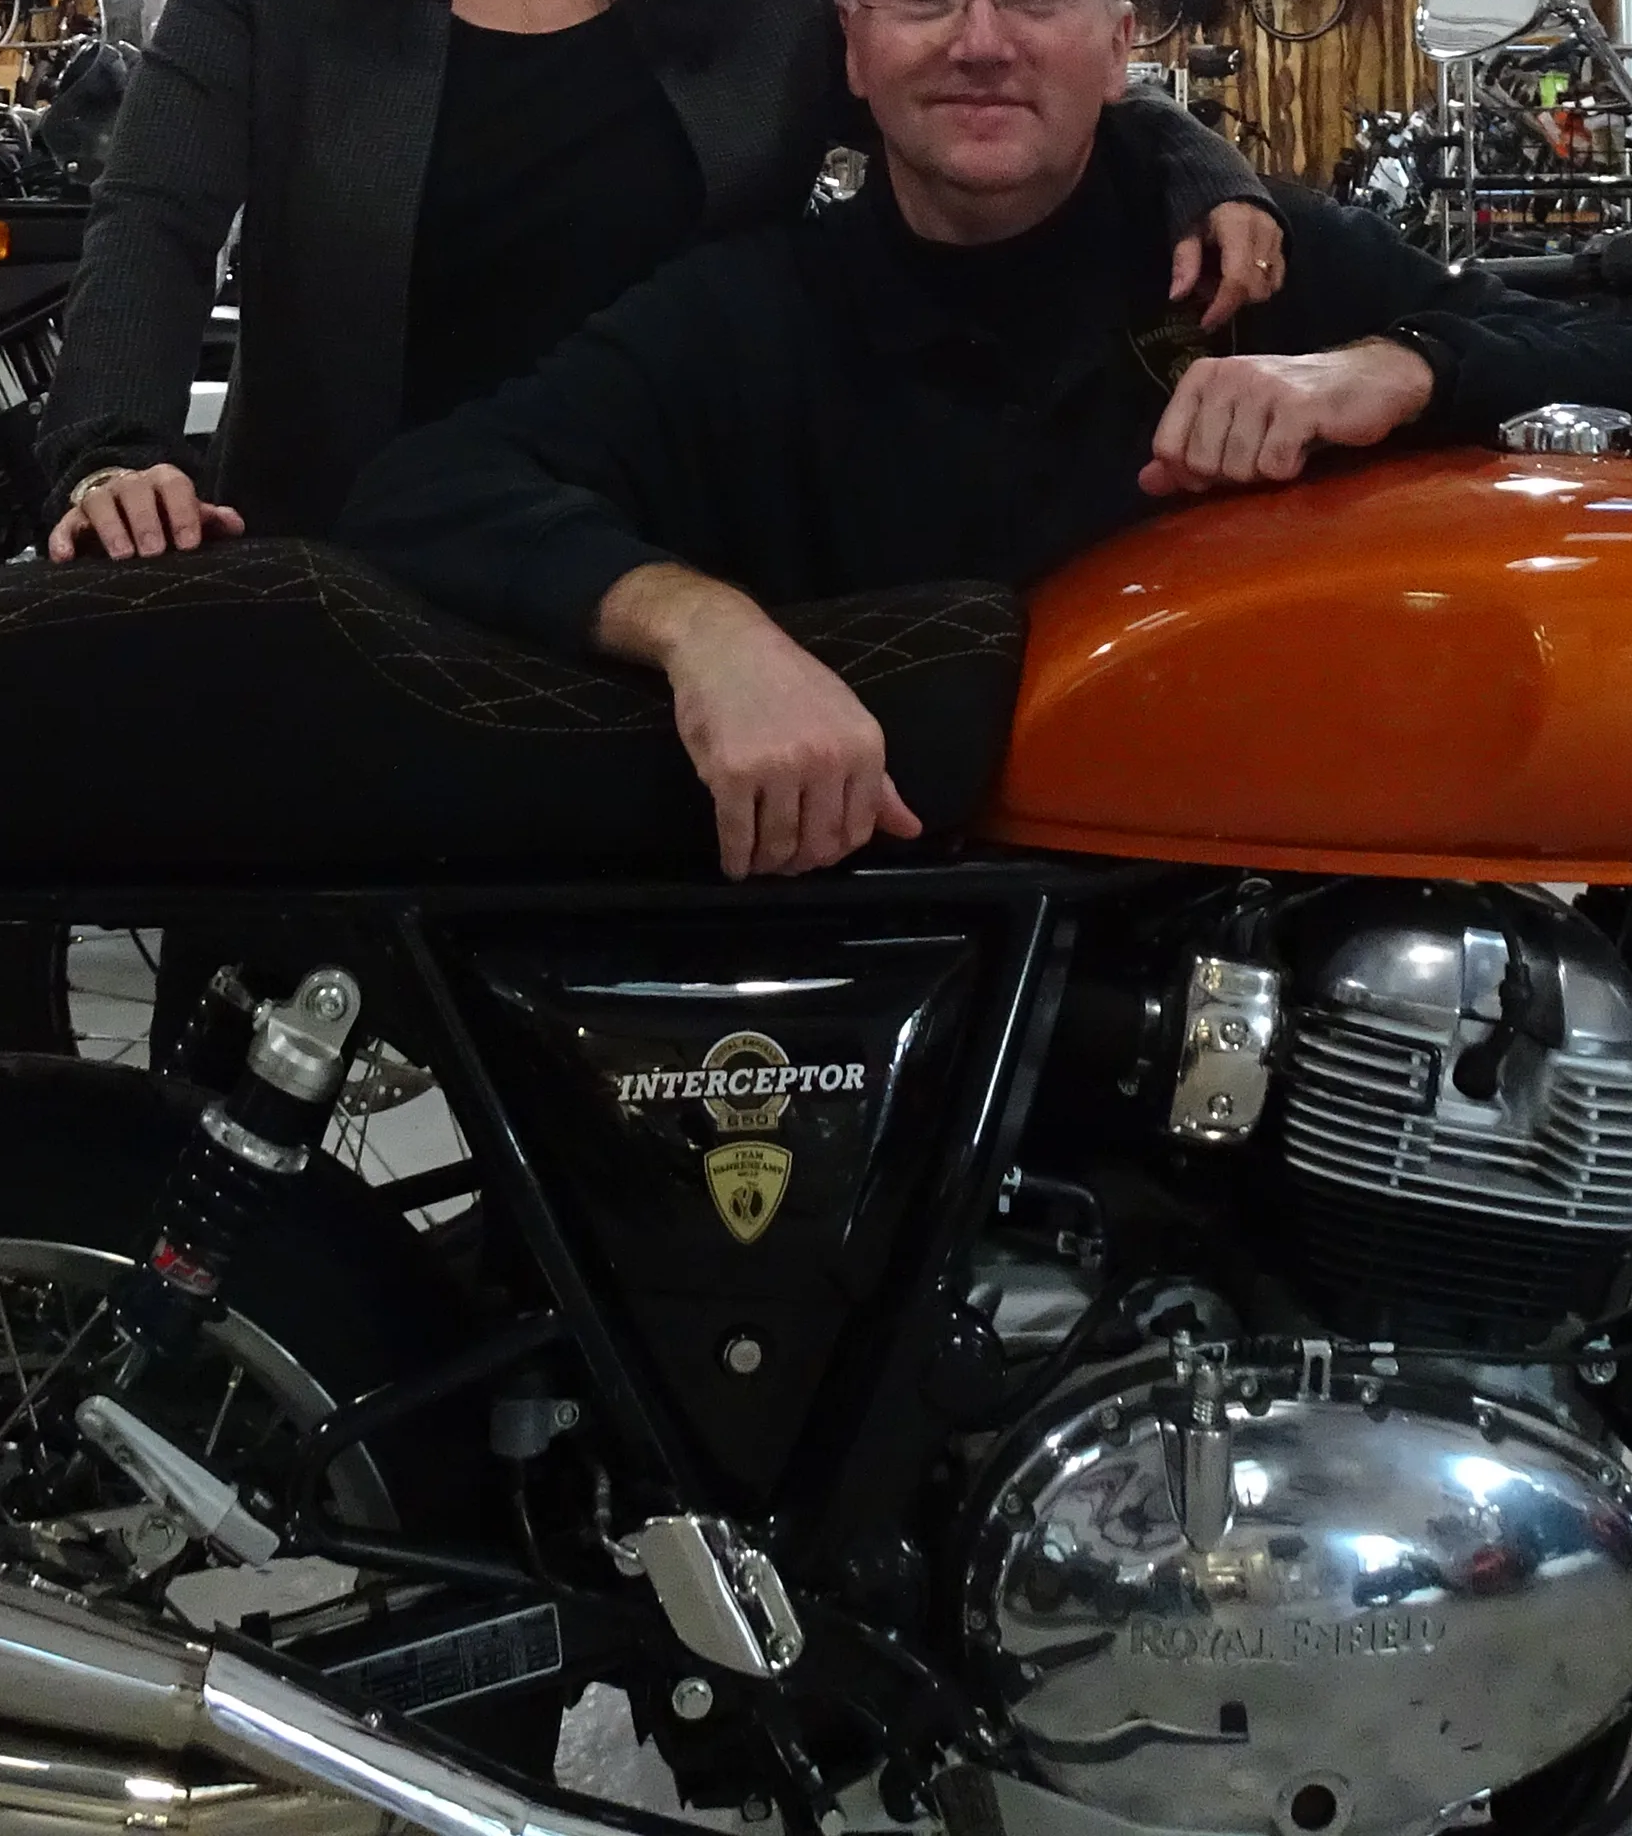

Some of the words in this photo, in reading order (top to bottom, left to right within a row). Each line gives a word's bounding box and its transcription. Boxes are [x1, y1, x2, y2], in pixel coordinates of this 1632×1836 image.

[618, 1063, 865, 1102] INTERCEPTOR
[1129, 1617, 1274, 1664] ROYAL
[1284, 1615, 1447, 1664] ENFIELD
